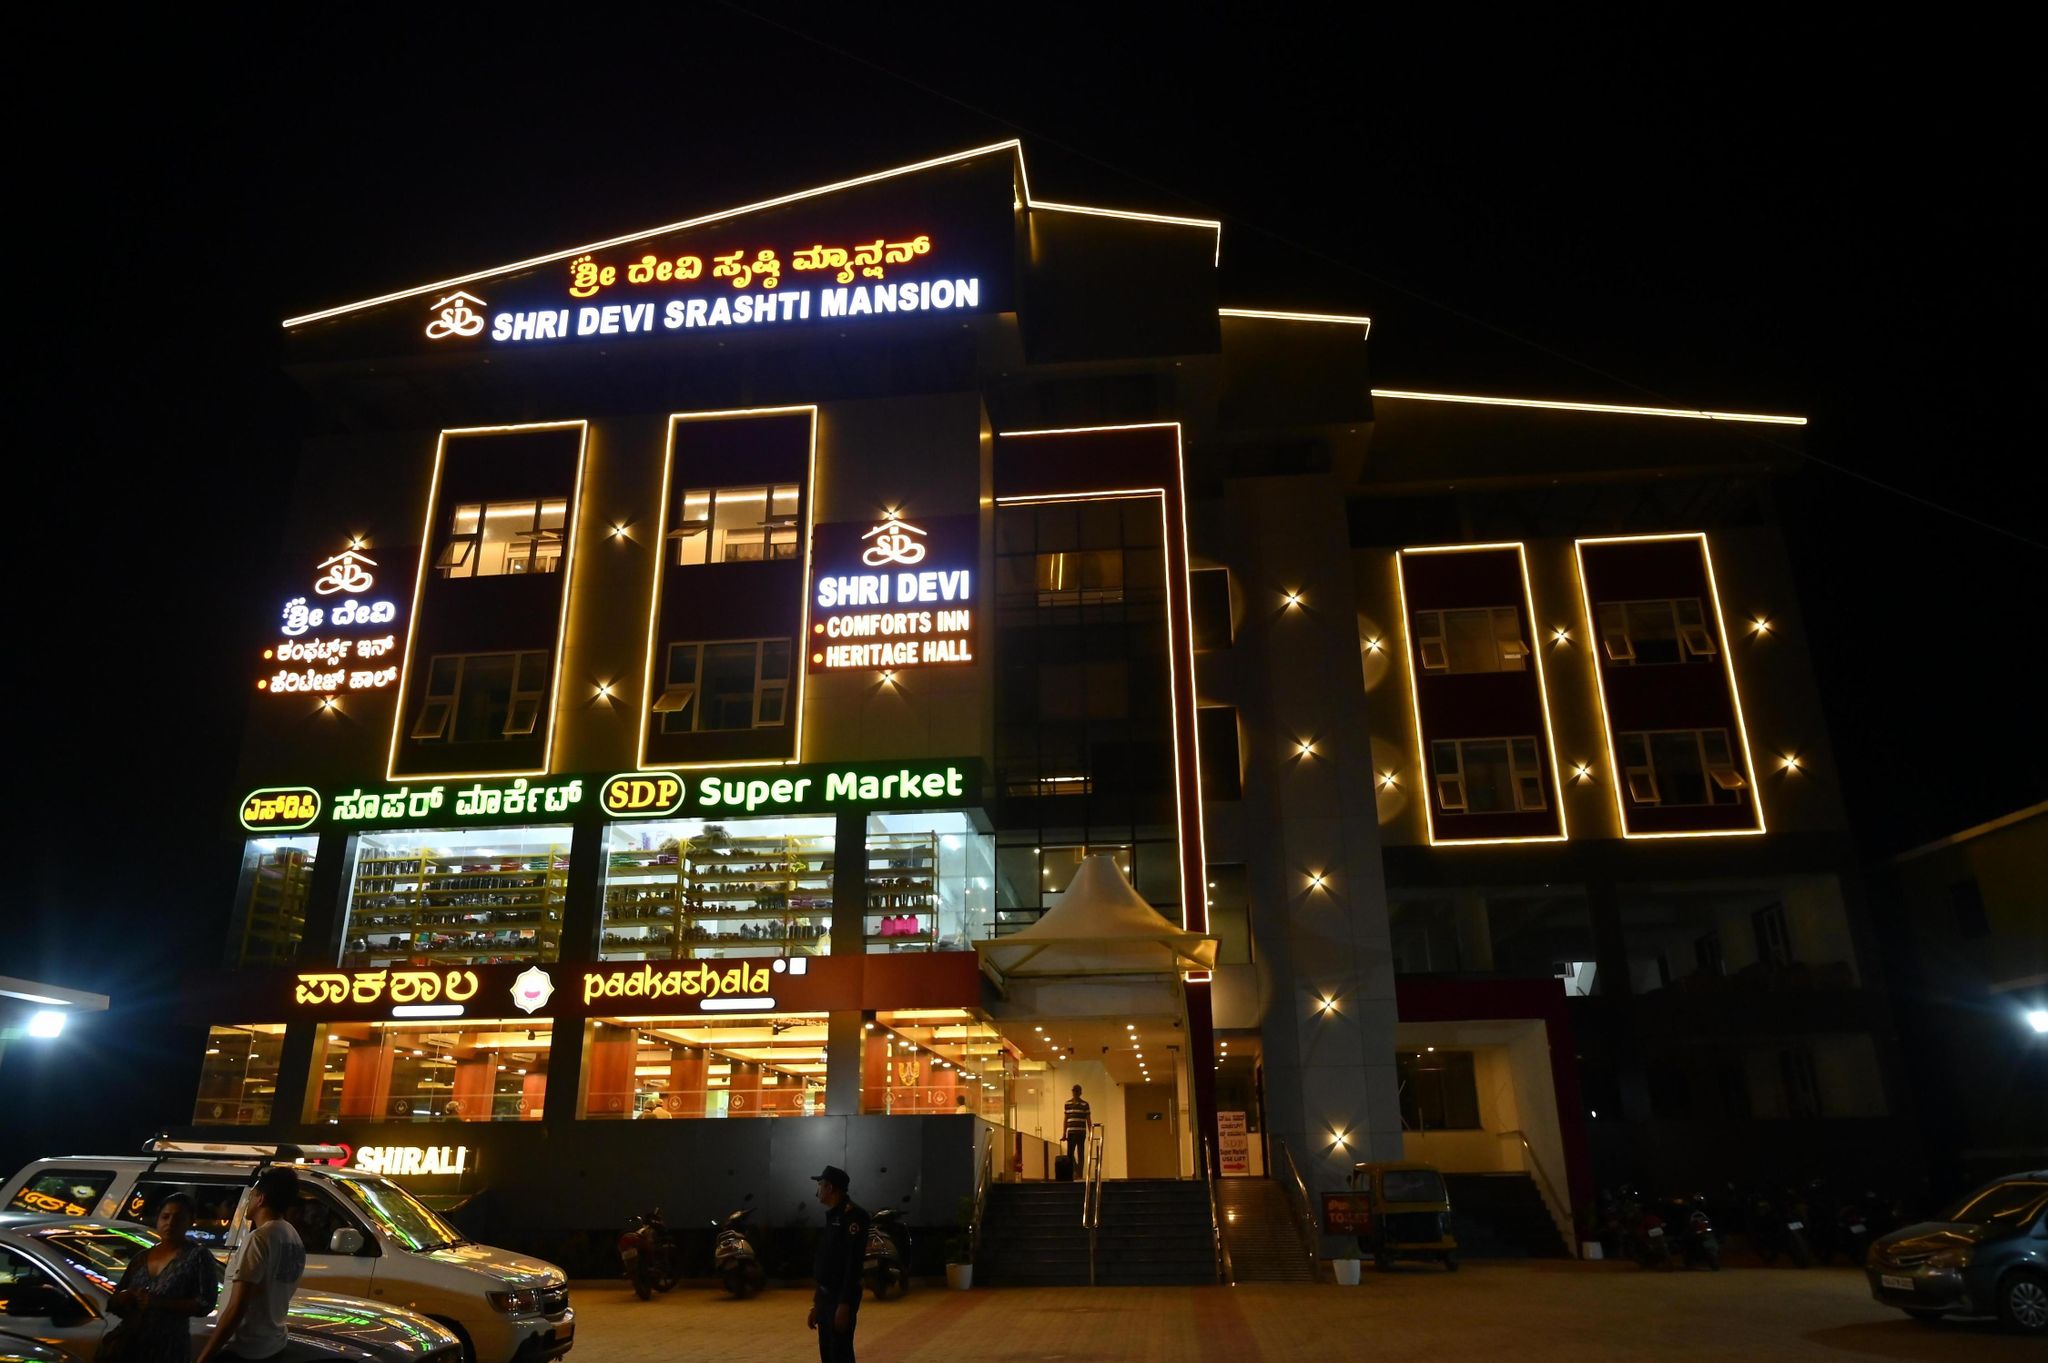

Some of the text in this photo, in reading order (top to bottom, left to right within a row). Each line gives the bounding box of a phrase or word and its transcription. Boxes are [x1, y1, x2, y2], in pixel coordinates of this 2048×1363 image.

[628, 255, 703, 284] ದೇವಿ
[491, 278, 979, 341] SHRI DEVI SRASHTI MANSION
[817, 570, 970, 608] SHRI DEVI
[331, 599, 396, 626] ದೇವಿ
[826, 609, 970, 638] COMFORTS INN
[356, 635, 394, 659] ಇನ್
[825, 639, 972, 668] HERITAGE HALL
[349, 666, 397, 689] ಹಾಲ್
[332, 786, 444, 820] ಸೂಪರ್
[608, 779, 679, 809] SDP
[699, 767, 963, 811] Super Market
[295, 969, 479, 1004] ಪಾಕಶಾಲ
[583, 961, 770, 1005] paakashala
[354, 1146, 467, 1175] SHIRALI
